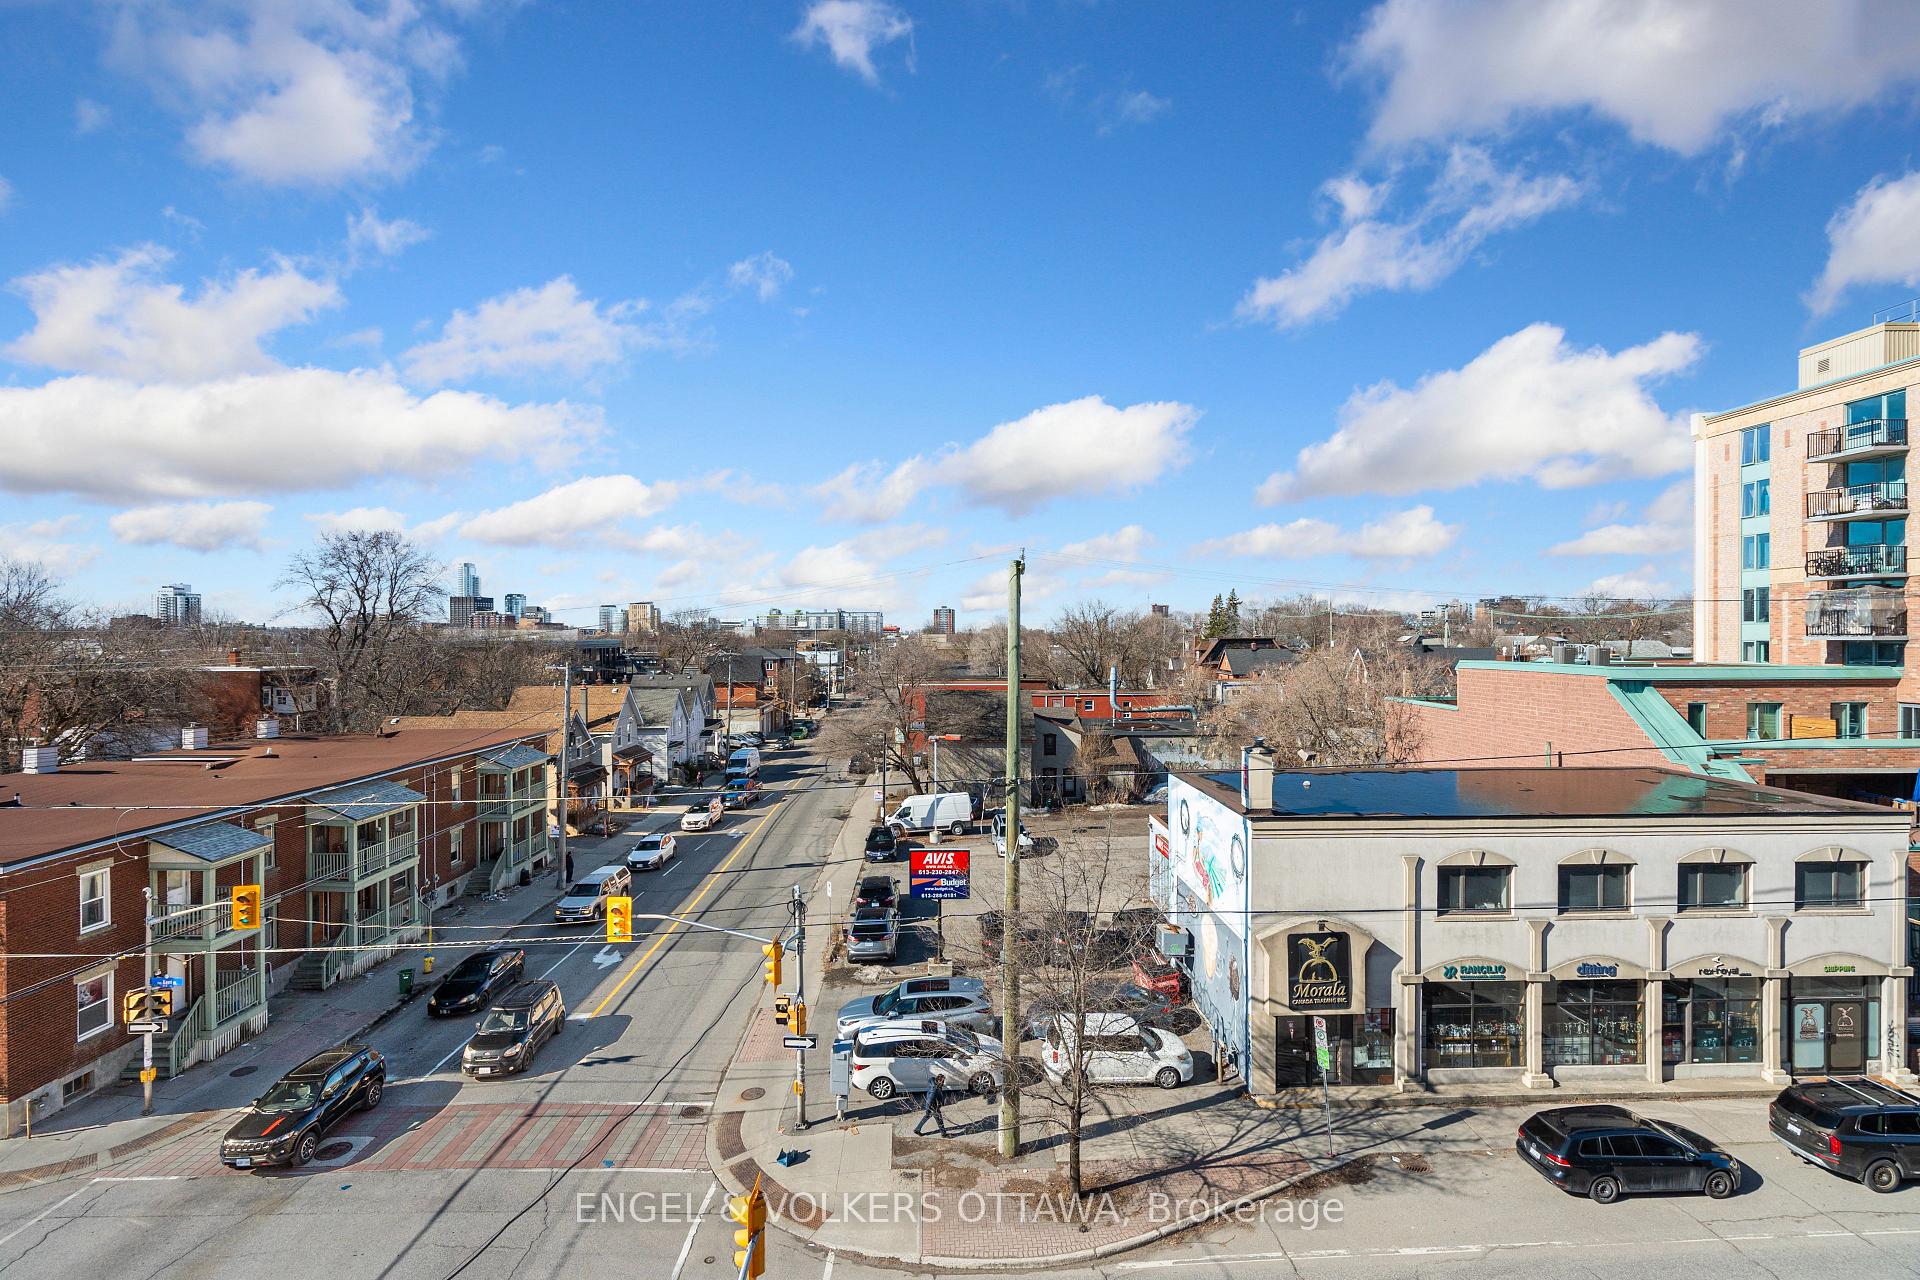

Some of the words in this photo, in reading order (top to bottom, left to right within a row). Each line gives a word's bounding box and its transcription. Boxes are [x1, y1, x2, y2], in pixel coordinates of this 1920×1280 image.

[922, 853, 954, 864] AVIS
[941, 878, 966, 887] Budget
[1460, 965, 1506, 975] RANCILIO
[1576, 962, 1618, 978] ditting
[1823, 965, 1856, 973] SHIPPING
[1293, 981, 1346, 998] Morala
